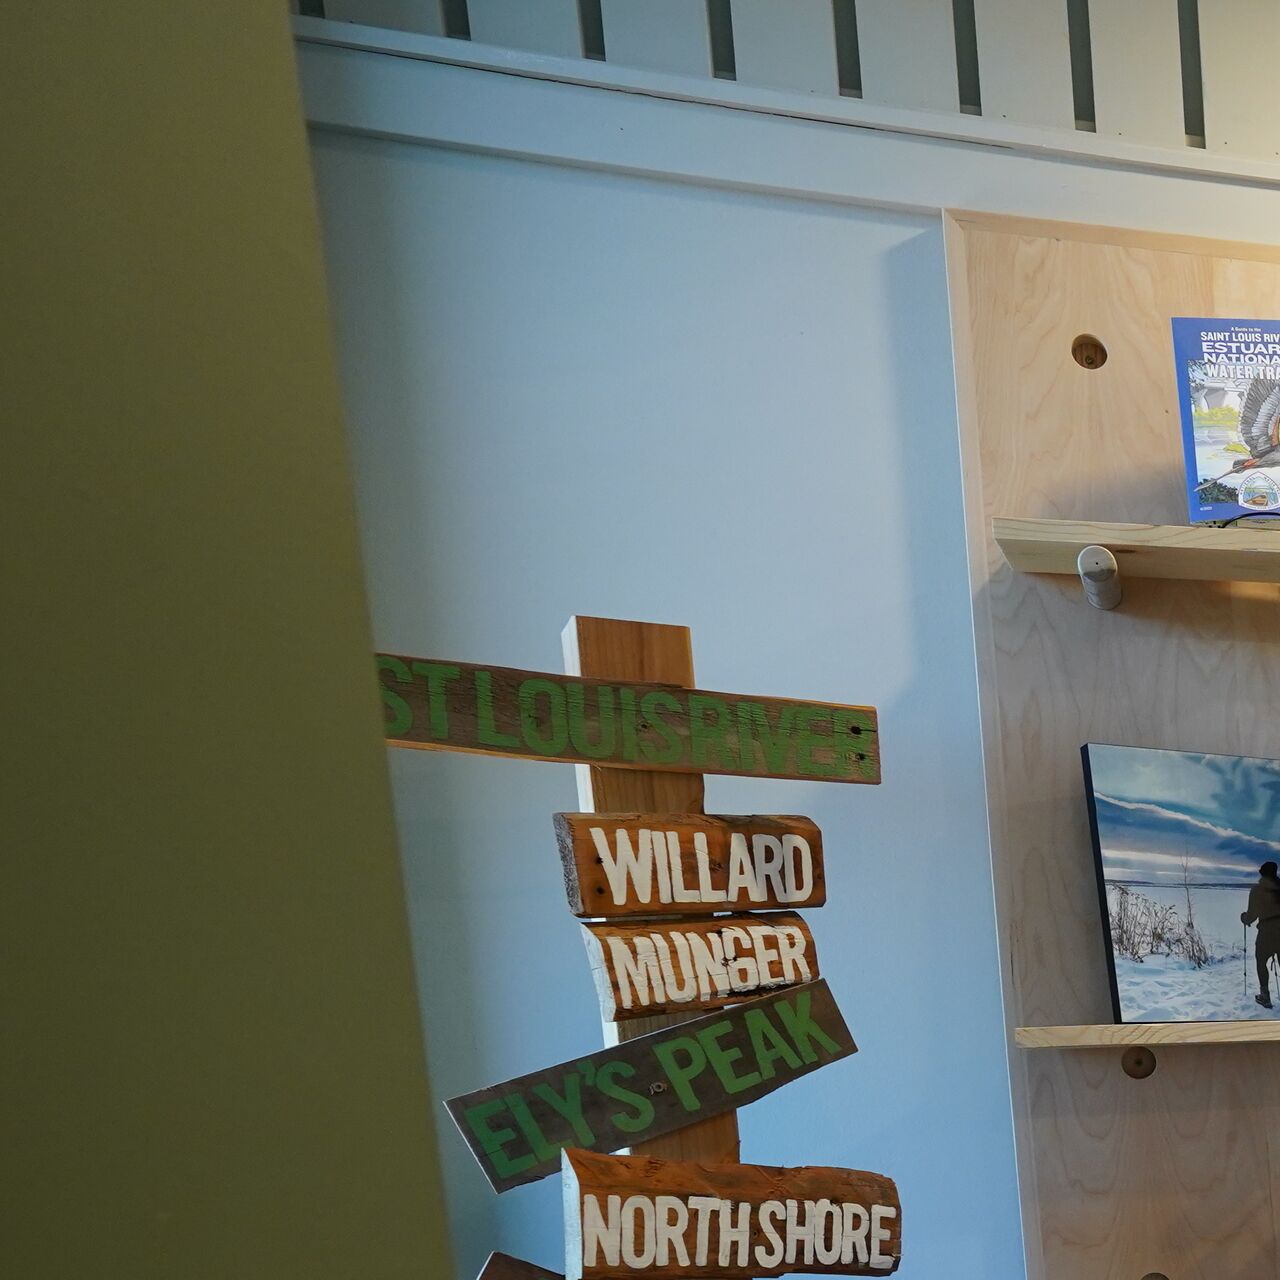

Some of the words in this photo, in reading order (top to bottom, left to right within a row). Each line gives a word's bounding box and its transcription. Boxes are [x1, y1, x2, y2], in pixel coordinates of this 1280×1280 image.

[1201, 331, 1230, 341] SAINT
[1232, 332, 1262, 342] LOUIS
[1206, 364, 1254, 379] WATER
[377, 656, 463, 741] ST
[474, 670, 687, 764] LOUIS
[687, 692, 877, 779] RIVER
[589, 827, 813, 906] WILLARD
[604, 924, 811, 1010] MUNGER
[465, 1061, 658, 1180] ELY'S
[653, 990, 841, 1117] PEAK
[582, 1194, 752, 1269] NORTH
[755, 1200, 898, 1269] SHORE
